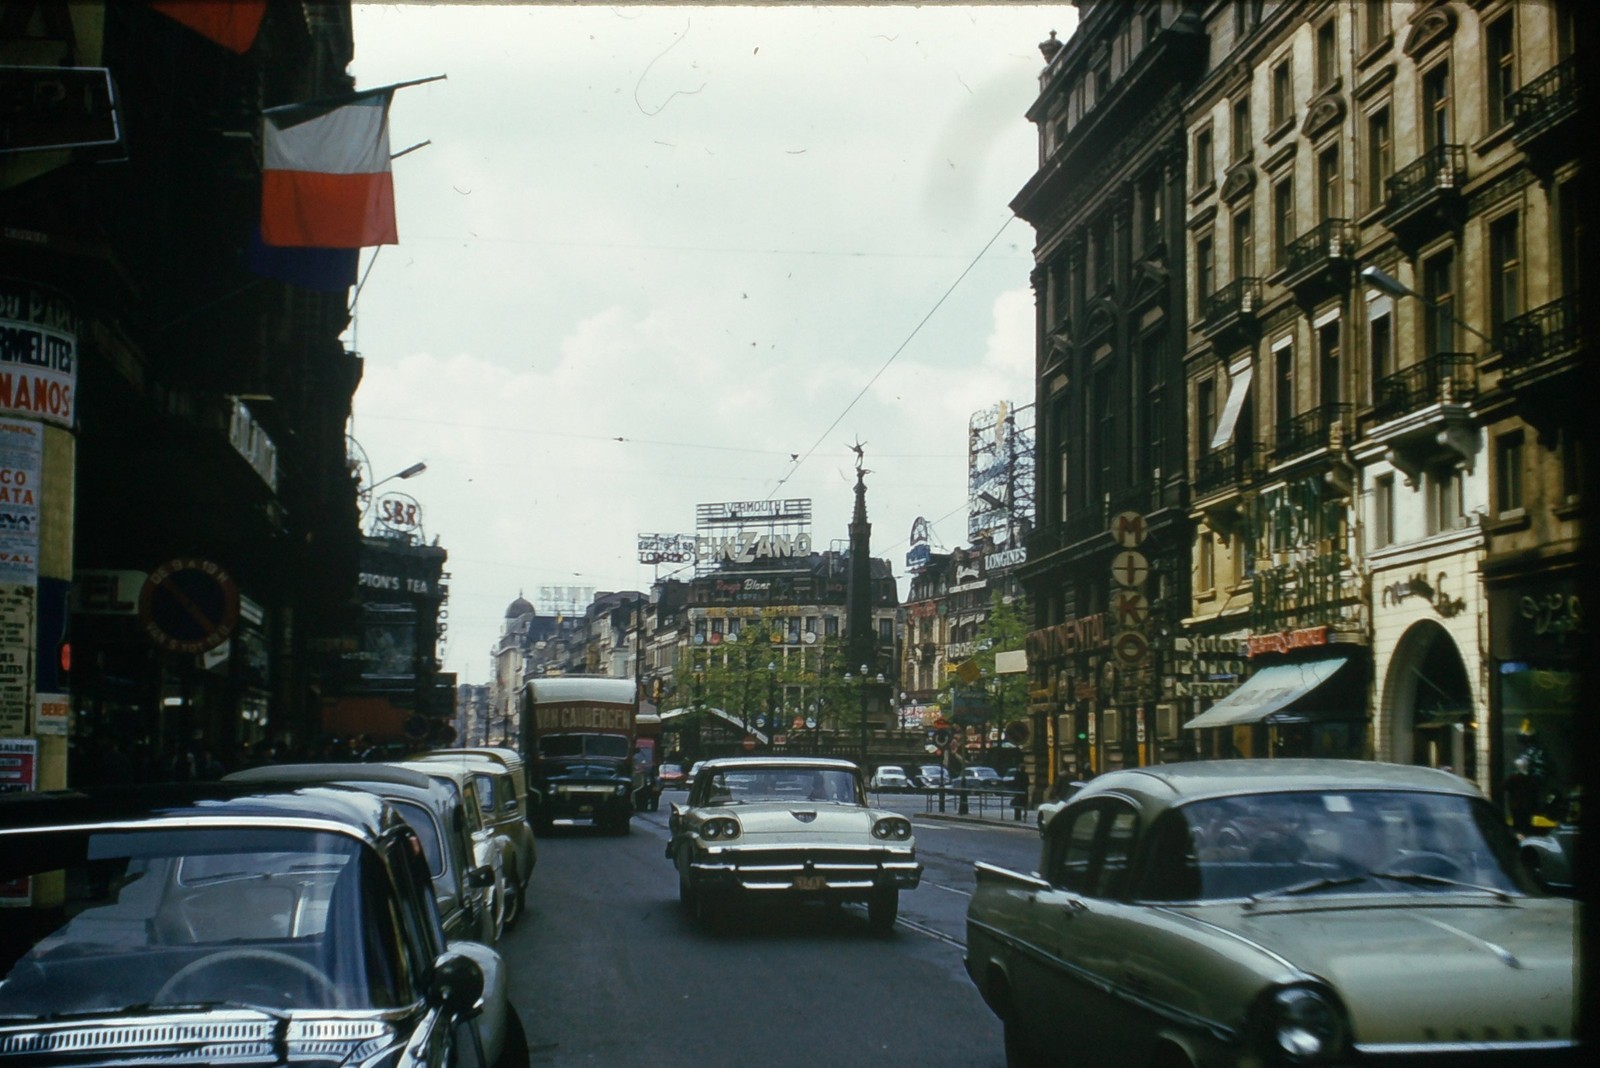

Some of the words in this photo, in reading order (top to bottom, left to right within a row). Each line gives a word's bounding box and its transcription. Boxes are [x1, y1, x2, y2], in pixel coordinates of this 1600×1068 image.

[383, 500, 416, 526] SBR
[728, 501, 782, 513] VERMOUTH
[695, 532, 811, 563] CINZANO
[984, 547, 1027, 570] LONGINES
[406, 578, 428, 593] TEA
